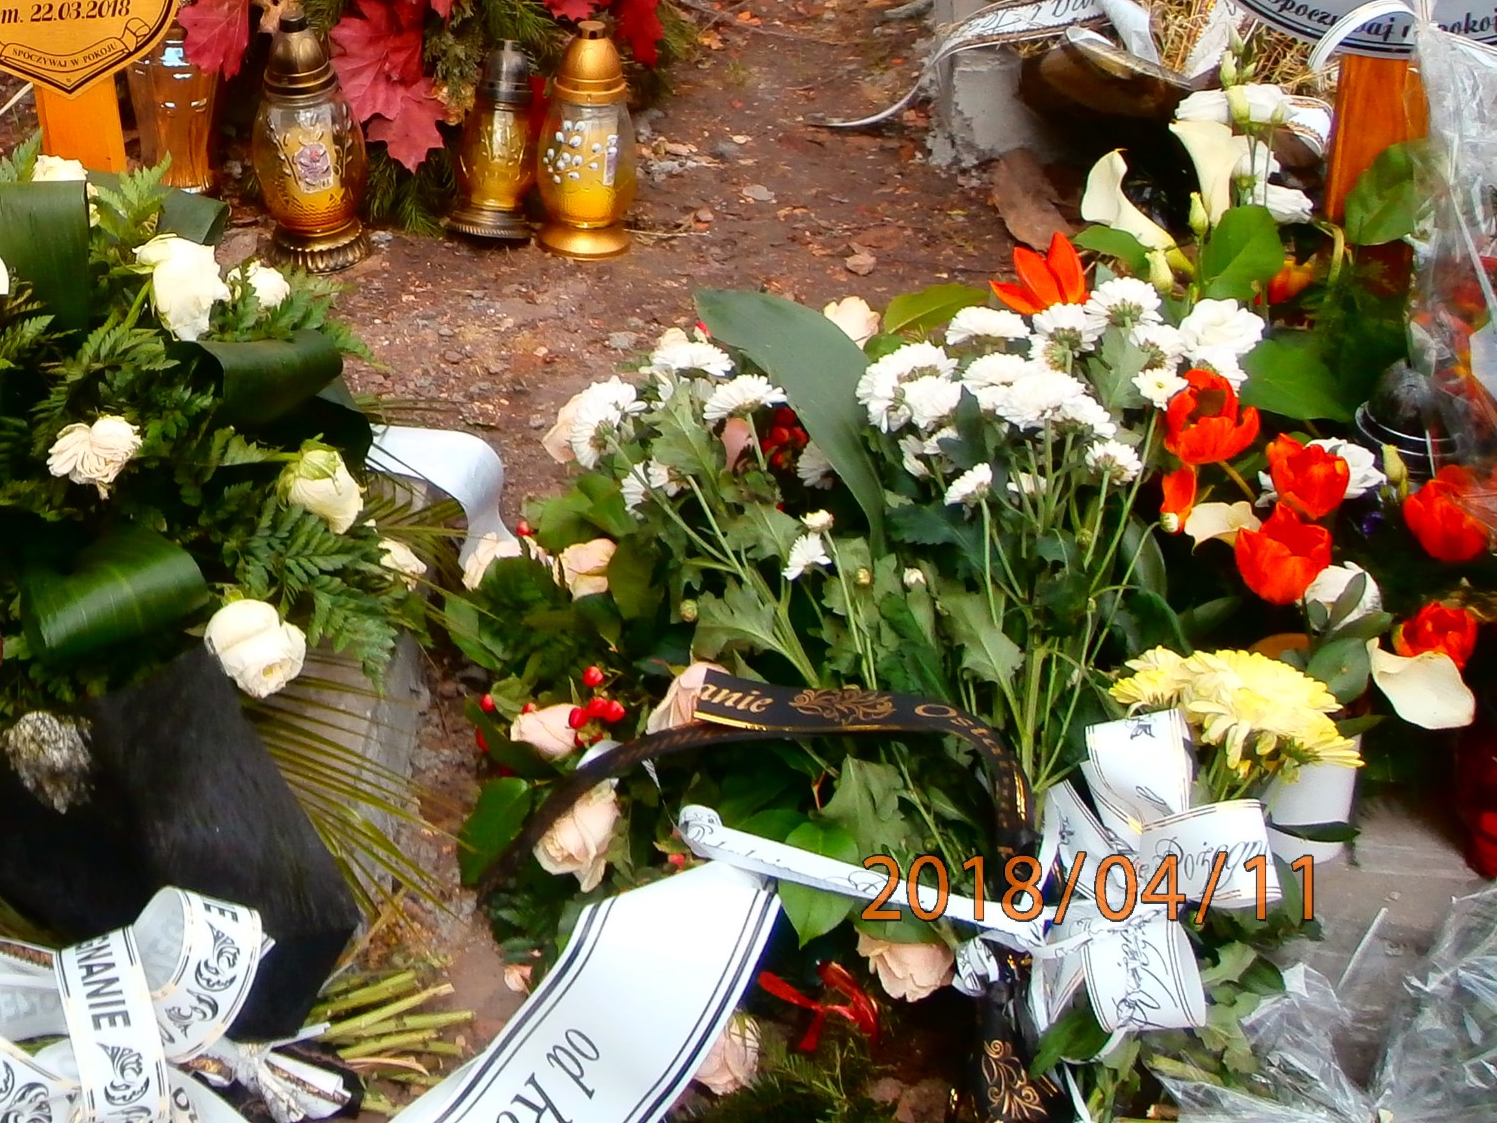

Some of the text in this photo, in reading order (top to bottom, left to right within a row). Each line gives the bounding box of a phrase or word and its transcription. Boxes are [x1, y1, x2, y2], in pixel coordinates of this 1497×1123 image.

[12, 42, 117, 67] SPOCZYWAJ W POKOJU
